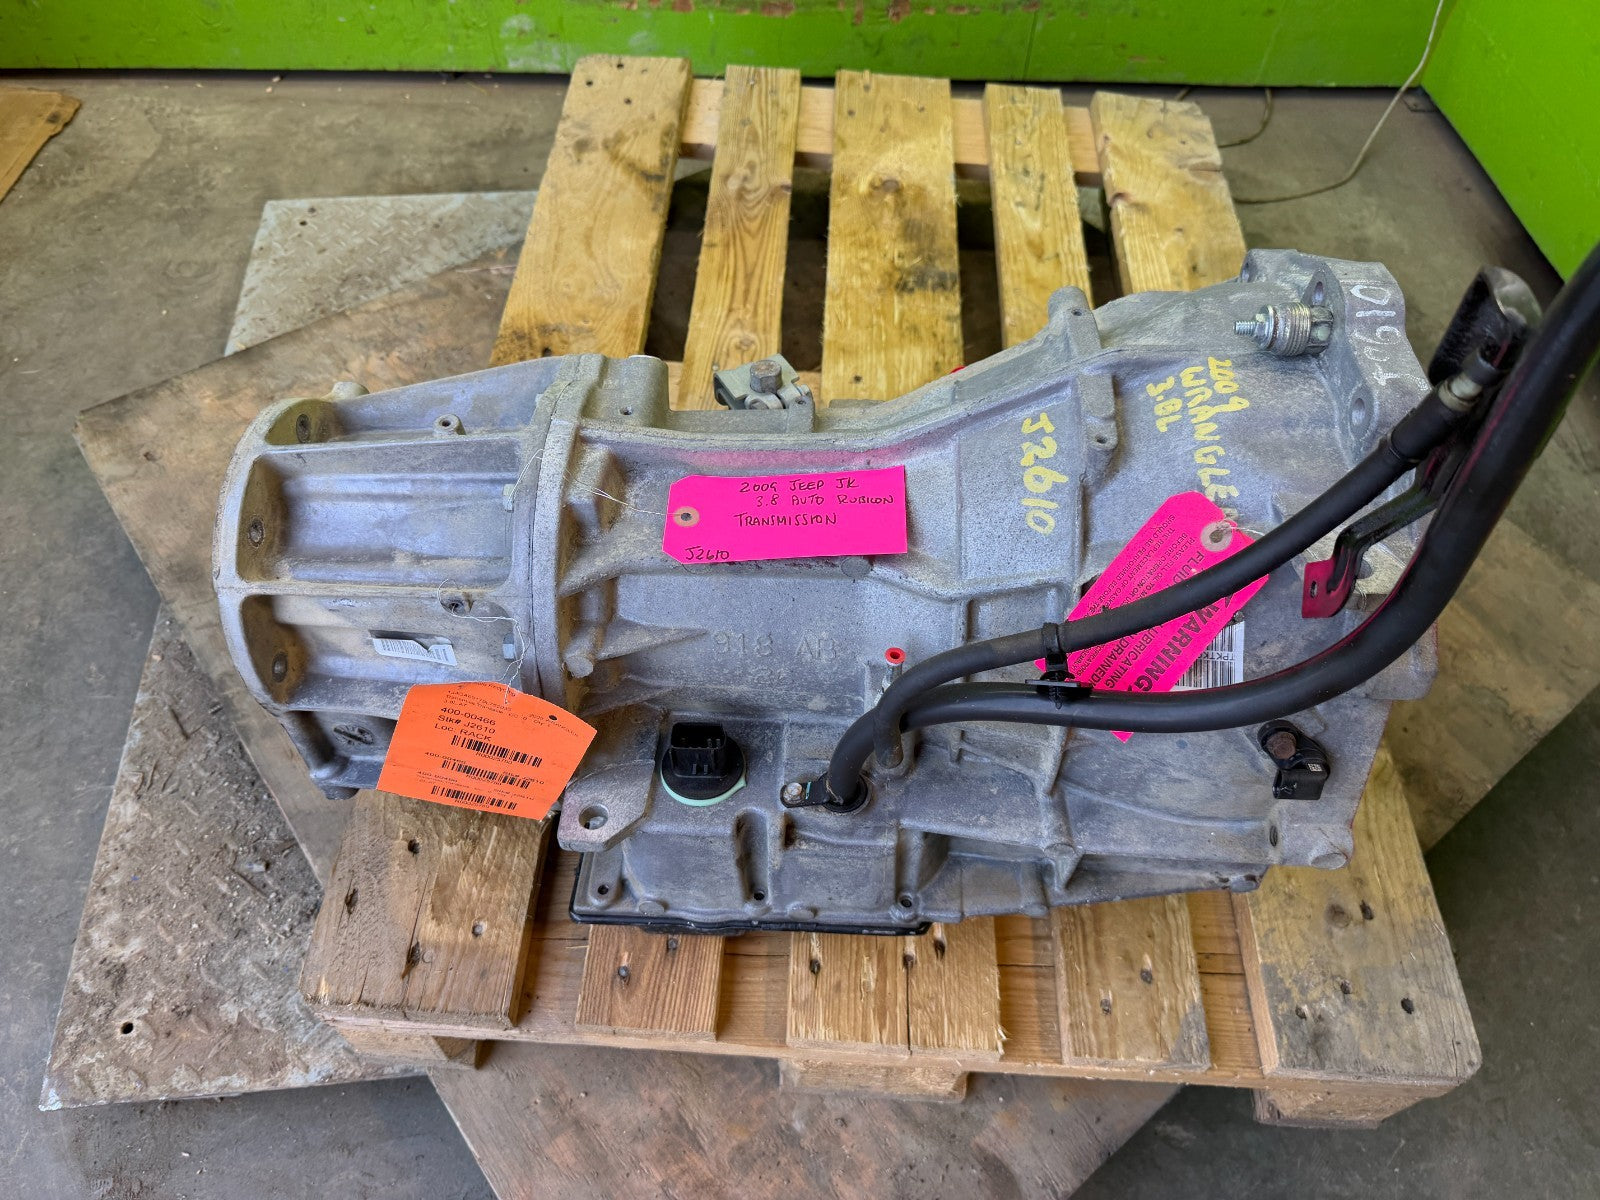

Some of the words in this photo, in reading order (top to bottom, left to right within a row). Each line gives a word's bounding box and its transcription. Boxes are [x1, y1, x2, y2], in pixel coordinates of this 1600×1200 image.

[1208, 356, 1250, 413] 2009
[1146, 376, 1183, 432] 3.8L
[1020, 412, 1068, 536] J2610
[739, 481, 778, 493] 2009
[789, 480, 825, 492] JEEP
[836, 477, 859, 489] JK
[756, 494, 779, 507] 3.8
[791, 495, 825, 505] AUTO
[837, 494, 894, 504] RUBICON
[734, 513, 837, 527] TRANSMISSION
[1151, 513, 1176, 540] SHOULD
[1143, 537, 1154, 548] BE
[1161, 525, 1175, 540] THE
[684, 545, 730, 561] J2610
[1164, 531, 1188, 558] BEFORE
[1171, 535, 1195, 562] PLEASE
[1114, 545, 1147, 582] PERFORMED
[1125, 537, 1164, 582] REPLACEMENT
[1160, 558, 1175, 573] FILL
[1171, 550, 1205, 586] FLUID
[1136, 554, 1167, 589] OPERATION
[1152, 571, 1163, 583] OIL
[1096, 579, 1117, 603] BEFORE
[1119, 578, 1129, 589] OF
[1128, 586, 1140, 598] OR
[1144, 581, 1154, 591] TO
[1105, 627, 1164, 688] UBRICATING
[1134, 606, 1219, 692] WARNING
[440, 706, 496, 726] 400-00466
[460, 728, 493, 742] RACK
[463, 720, 496, 735] J2610
